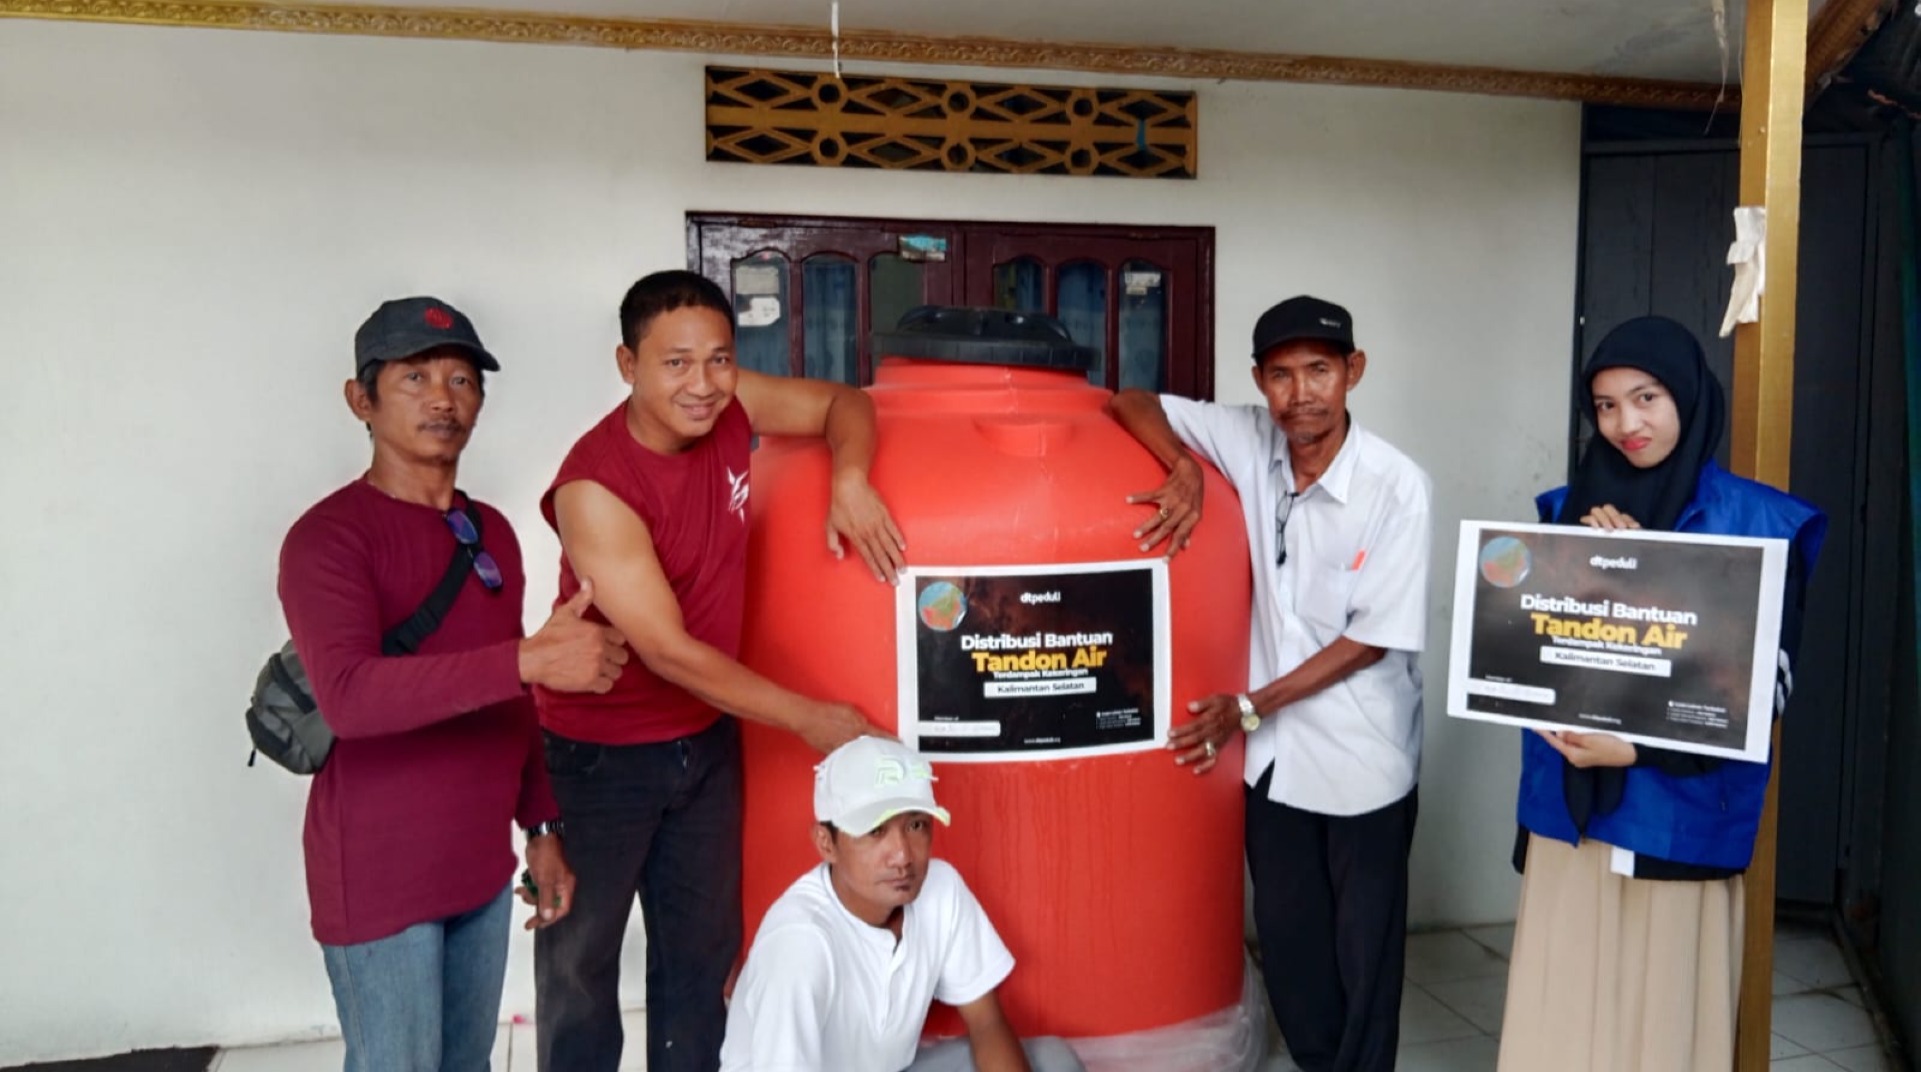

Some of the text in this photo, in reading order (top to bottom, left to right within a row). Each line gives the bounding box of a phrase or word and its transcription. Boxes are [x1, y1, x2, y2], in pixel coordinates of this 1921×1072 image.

[1590, 555, 1638, 570] dtpeduli
[1020, 591, 1061, 605] dtpeduli
[1520, 594, 1697, 625] Distribusi Bantuan
[960, 630, 1114, 650] Distribusi Bantuan
[1531, 612, 1688, 650] Tandon Air
[971, 645, 1107, 673] Tandon Air
[1555, 651, 1655, 670] Kalimantan Selatan
[997, 681, 1085, 694] Kalimantan Selatan
